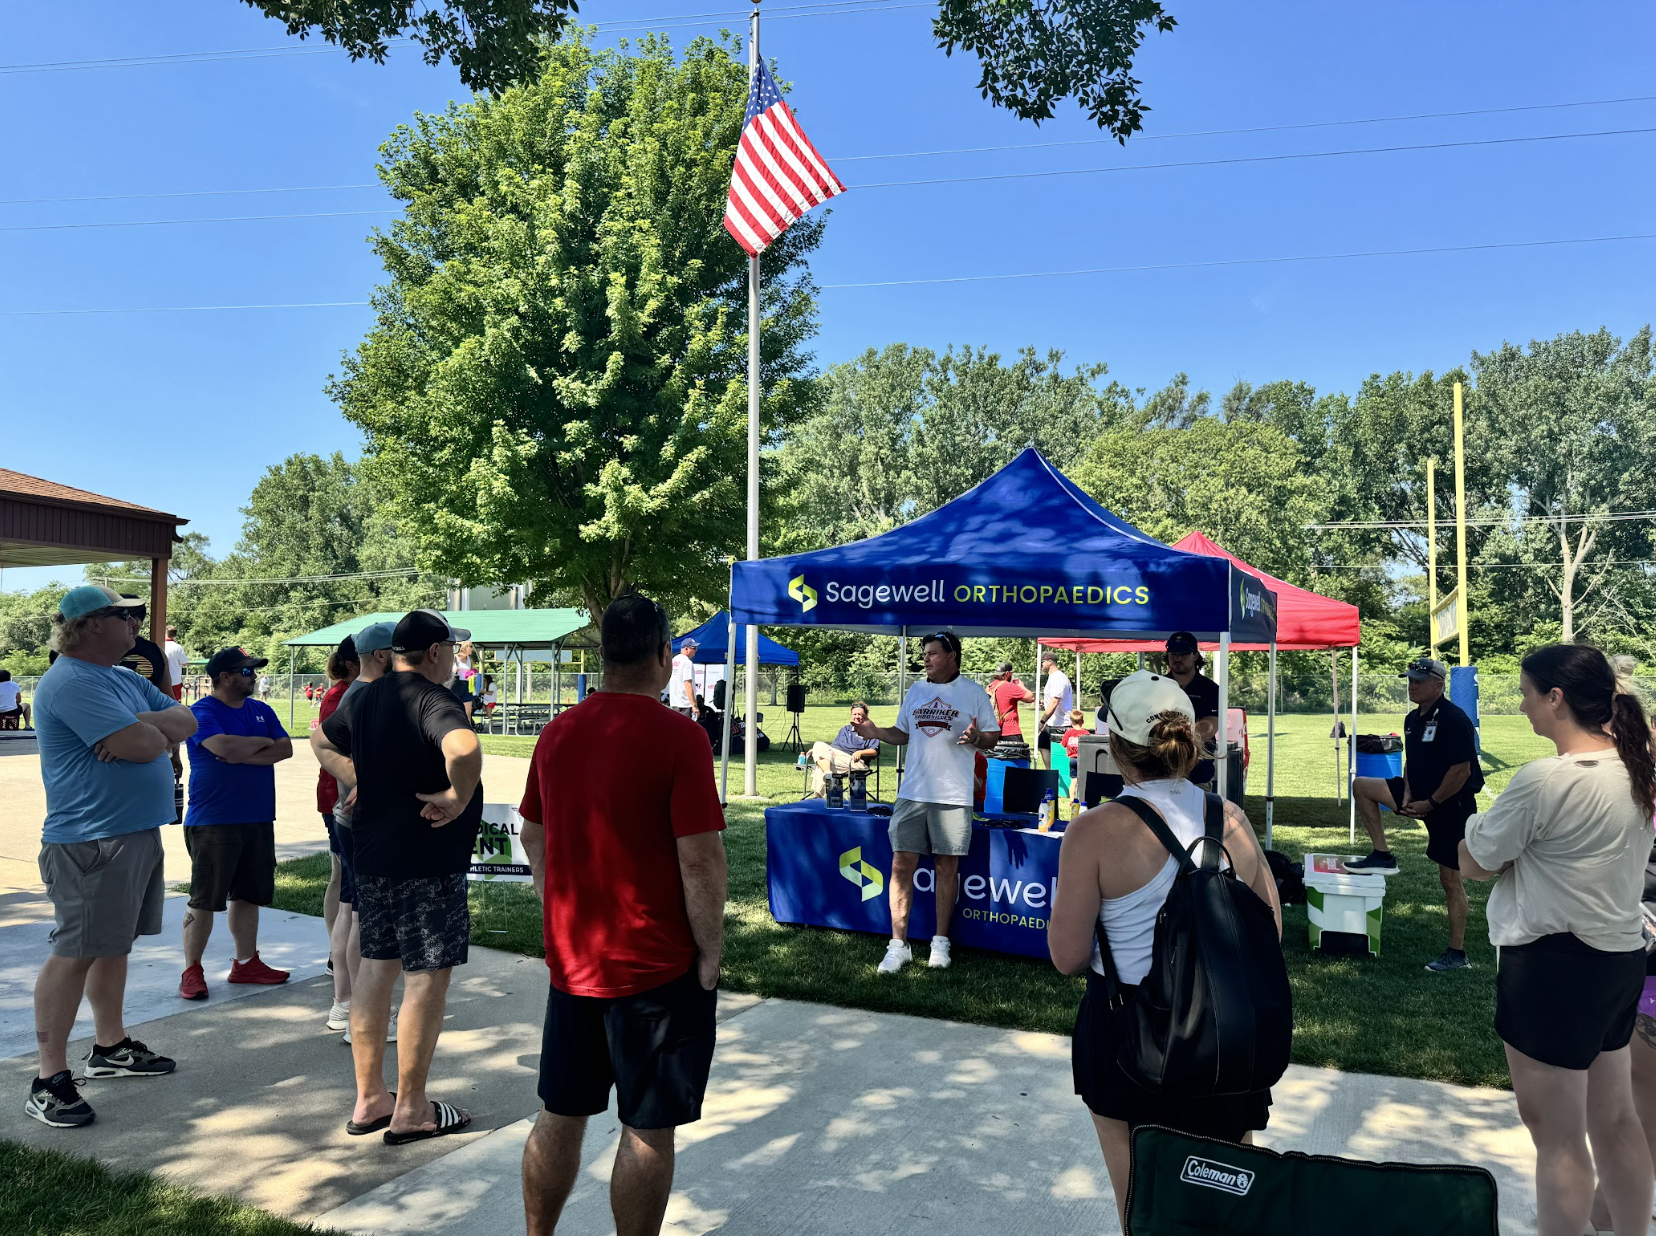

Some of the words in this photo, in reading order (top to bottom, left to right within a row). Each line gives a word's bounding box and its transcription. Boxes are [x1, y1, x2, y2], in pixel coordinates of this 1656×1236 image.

[826, 580, 945, 609] Sagewell
[954, 585, 1149, 605] ORTHOPAEDICS
[912, 867, 1057, 908] aewel
[1187, 1159, 1237, 1186] Coleman
